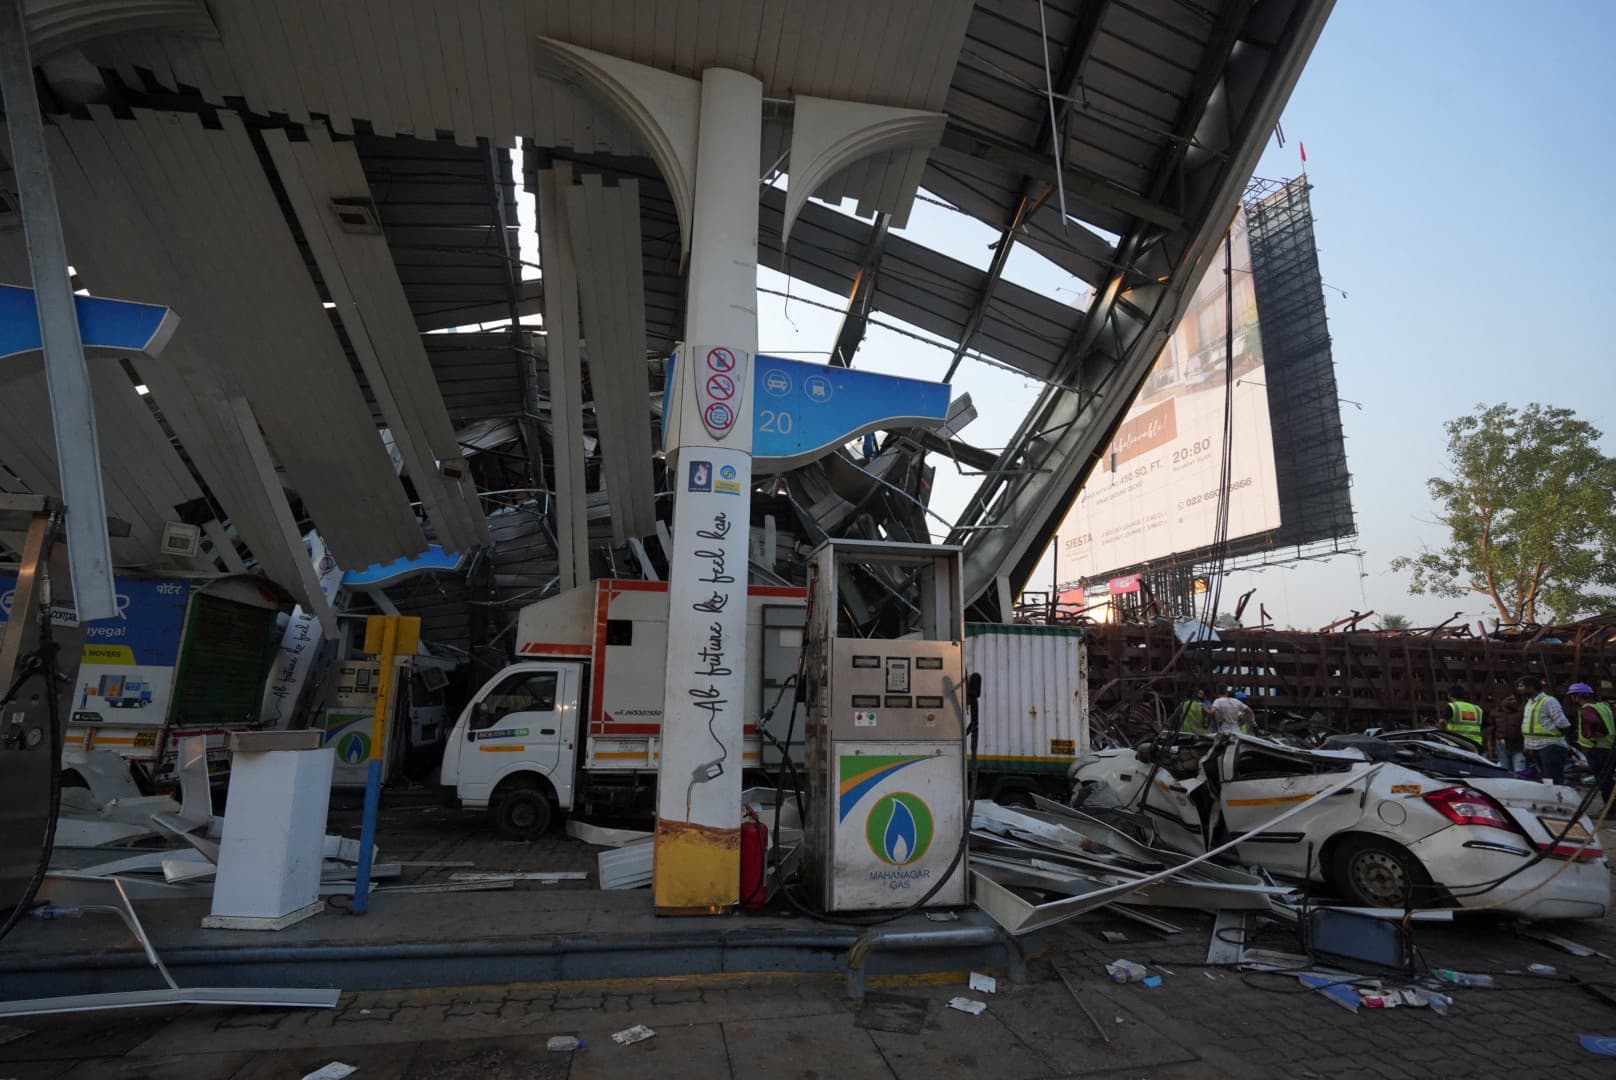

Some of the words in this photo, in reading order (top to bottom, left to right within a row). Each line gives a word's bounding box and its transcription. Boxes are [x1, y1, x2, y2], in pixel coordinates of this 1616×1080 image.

[759, 409, 793, 435] 20
[1065, 531, 1093, 550] SIESTA
[694, 547, 735, 584] feel
[692, 593, 729, 613] ko
[694, 621, 732, 677] future
[689, 684, 728, 712] Ab
[869, 869, 930, 881] MAHANAGAR
[889, 880, 911, 890] GAS
